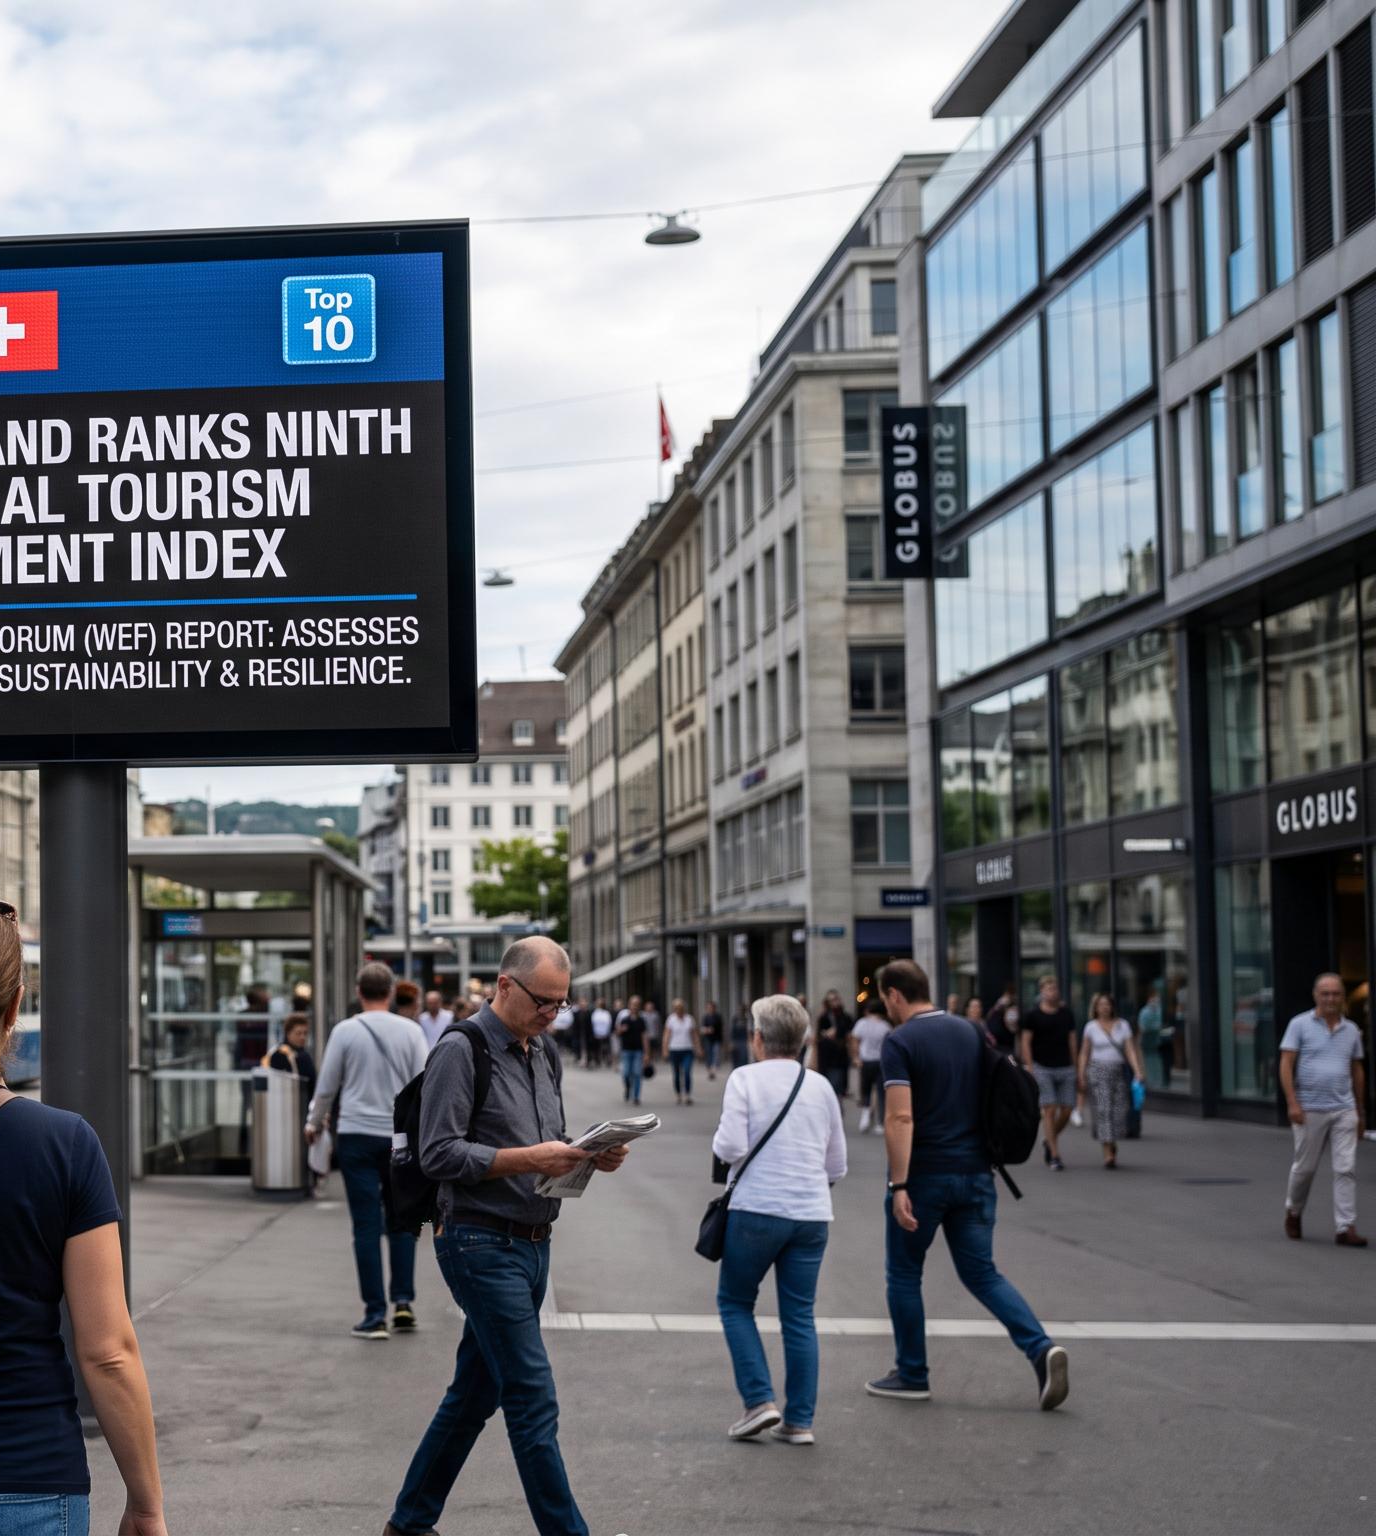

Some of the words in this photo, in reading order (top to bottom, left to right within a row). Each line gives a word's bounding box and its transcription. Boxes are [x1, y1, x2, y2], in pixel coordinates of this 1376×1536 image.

[304, 288, 353, 314] Top
[304, 314, 354, 351] 10
[88, 413, 251, 463] RANKS
[266, 408, 412, 458] NINTH
[77, 468, 311, 523] TOURISM
[892, 423, 920, 563] GLOBUS
[130, 528, 288, 582] INDEX
[84, 623, 157, 658] (WEF)
[166, 620, 274, 650] REPORT:
[281, 616, 420, 647] ASSESSES
[219, 659, 240, 688] &
[248, 656, 412, 687] RESILIENCE.
[1276, 786, 1357, 834] GLOBUS
